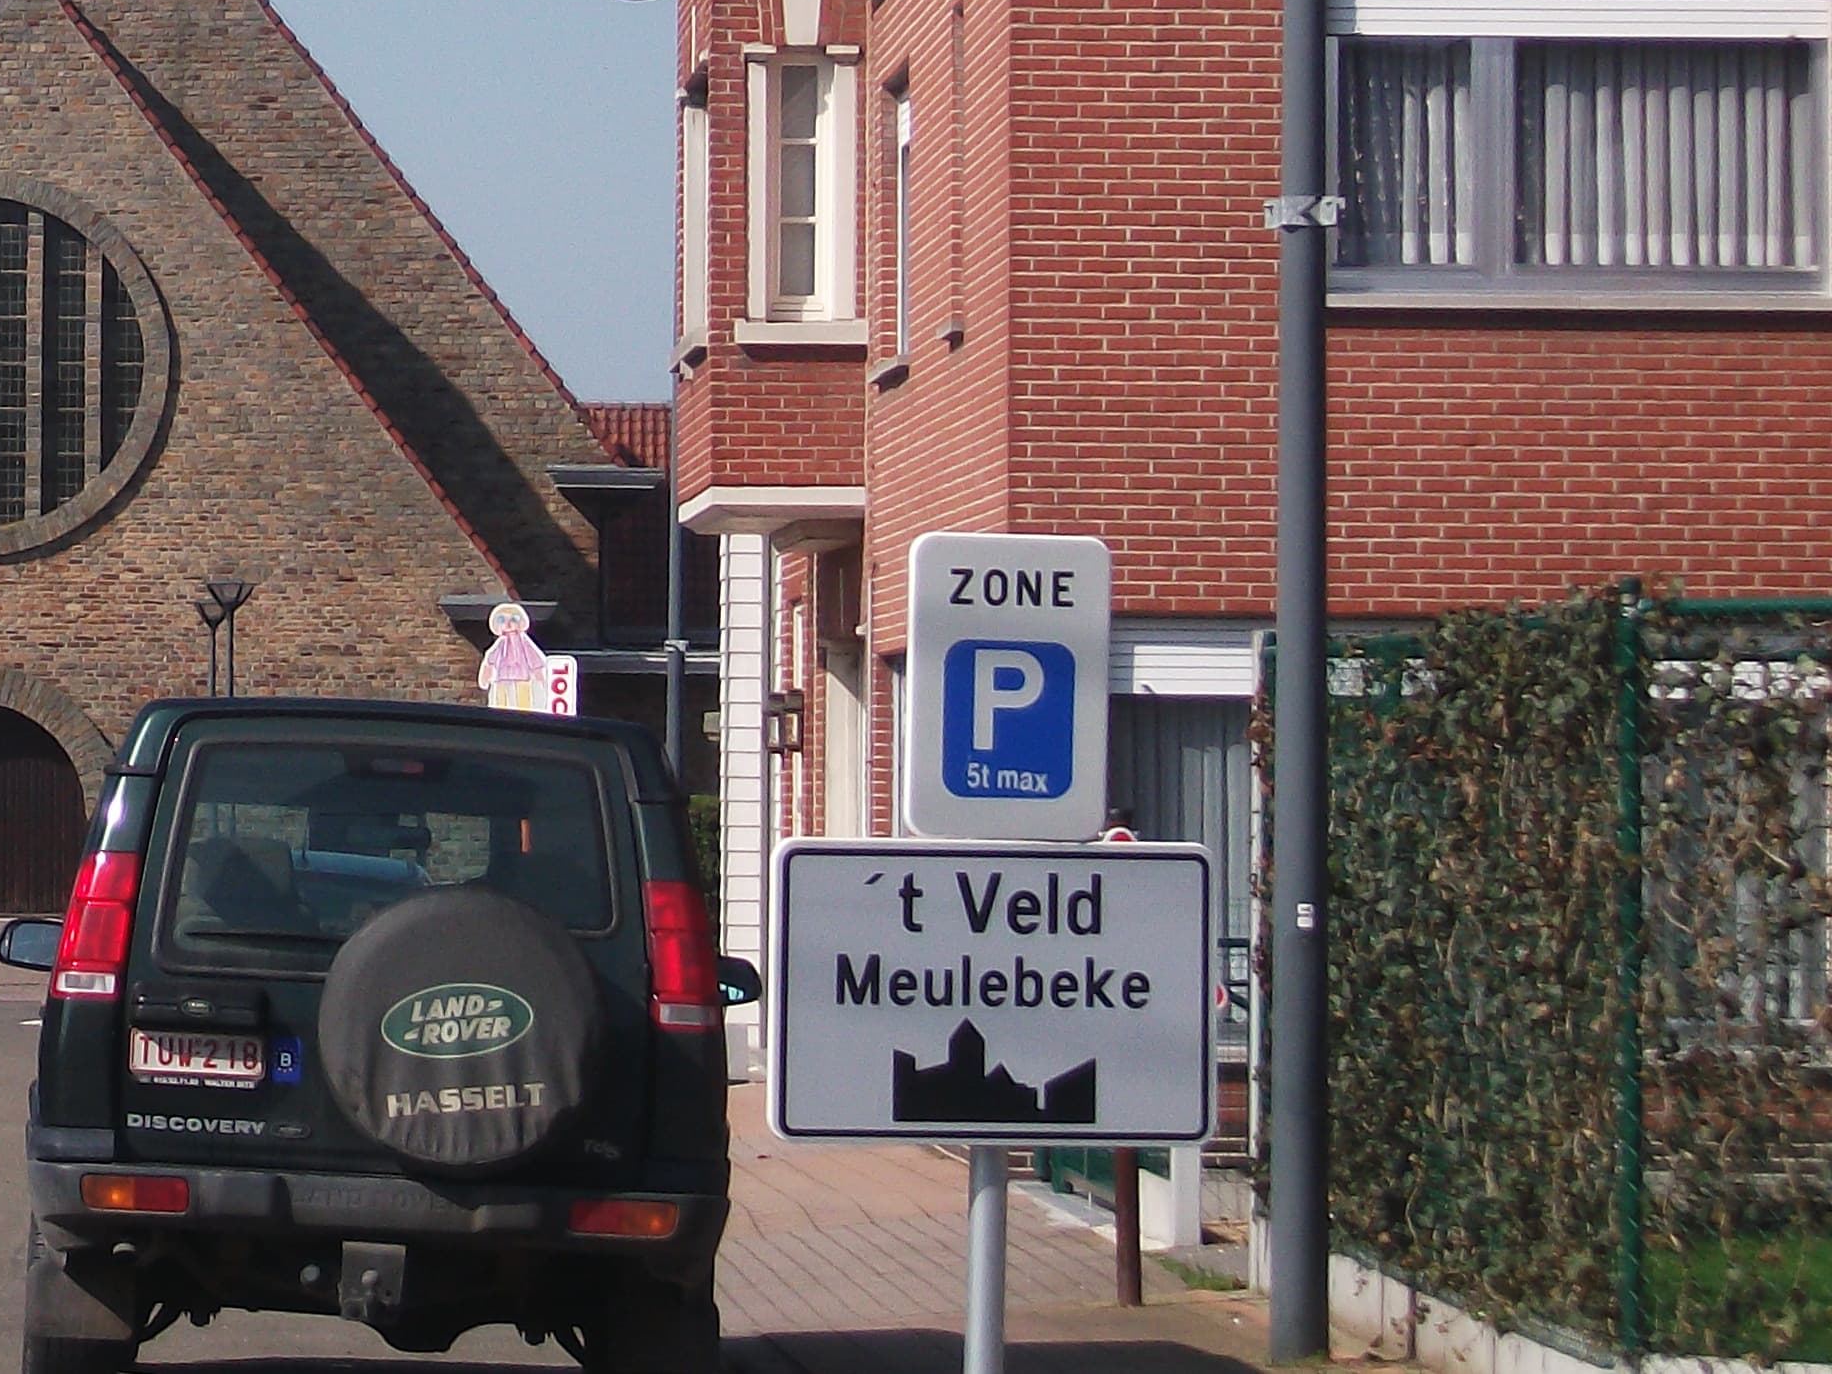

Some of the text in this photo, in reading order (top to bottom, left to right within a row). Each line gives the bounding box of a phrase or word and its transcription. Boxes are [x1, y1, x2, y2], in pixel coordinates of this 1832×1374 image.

[949, 569, 1075, 607] ZONE
[973, 649, 1045, 750] P
[967, 762, 1048, 792] 5t max
[957, 872, 1102, 936] Veld
[835, 953, 1150, 1008] Meulebeke
[411, 994, 485, 1023] LAND
[421, 1016, 512, 1045] ROVER
[280, 1053, 292, 1067] B
[386, 1082, 546, 1118] HASSELT
[126, 1113, 266, 1135] DISCOVERY
